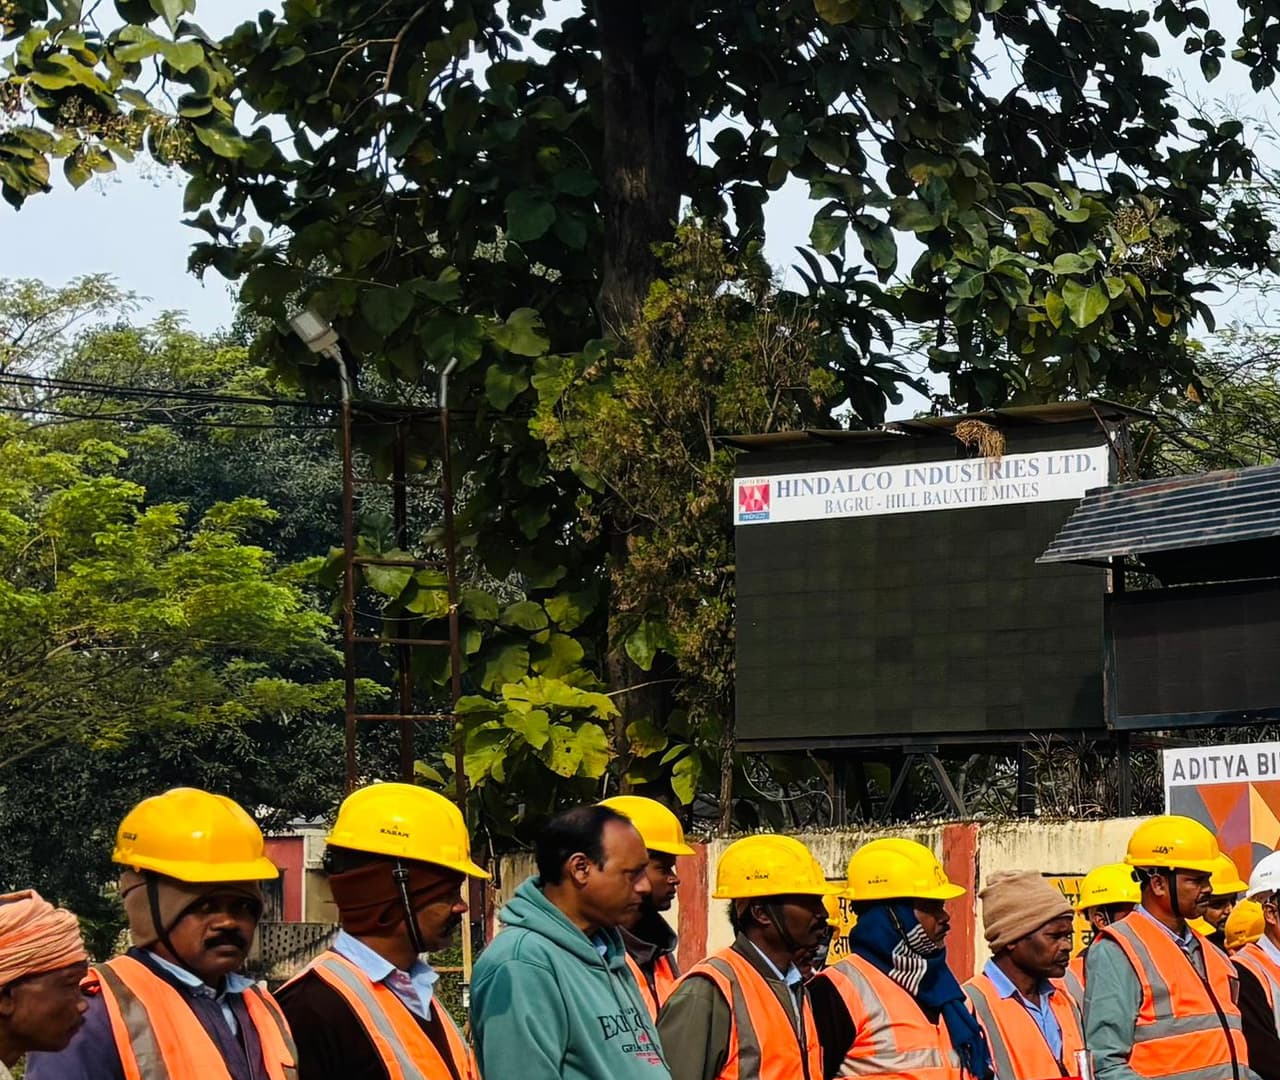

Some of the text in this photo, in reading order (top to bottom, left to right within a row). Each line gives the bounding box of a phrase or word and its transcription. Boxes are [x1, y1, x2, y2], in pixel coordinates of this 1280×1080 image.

[777, 453, 1097, 498] HINDALCO INDUSTRIES LTD.
[825, 496, 873, 514] BAGRU
[886, 492, 920, 510] HILL
[923, 486, 988, 506] BAUXITE
[993, 482, 1040, 500] MINES
[1172, 754, 1250, 781] ADITYA
